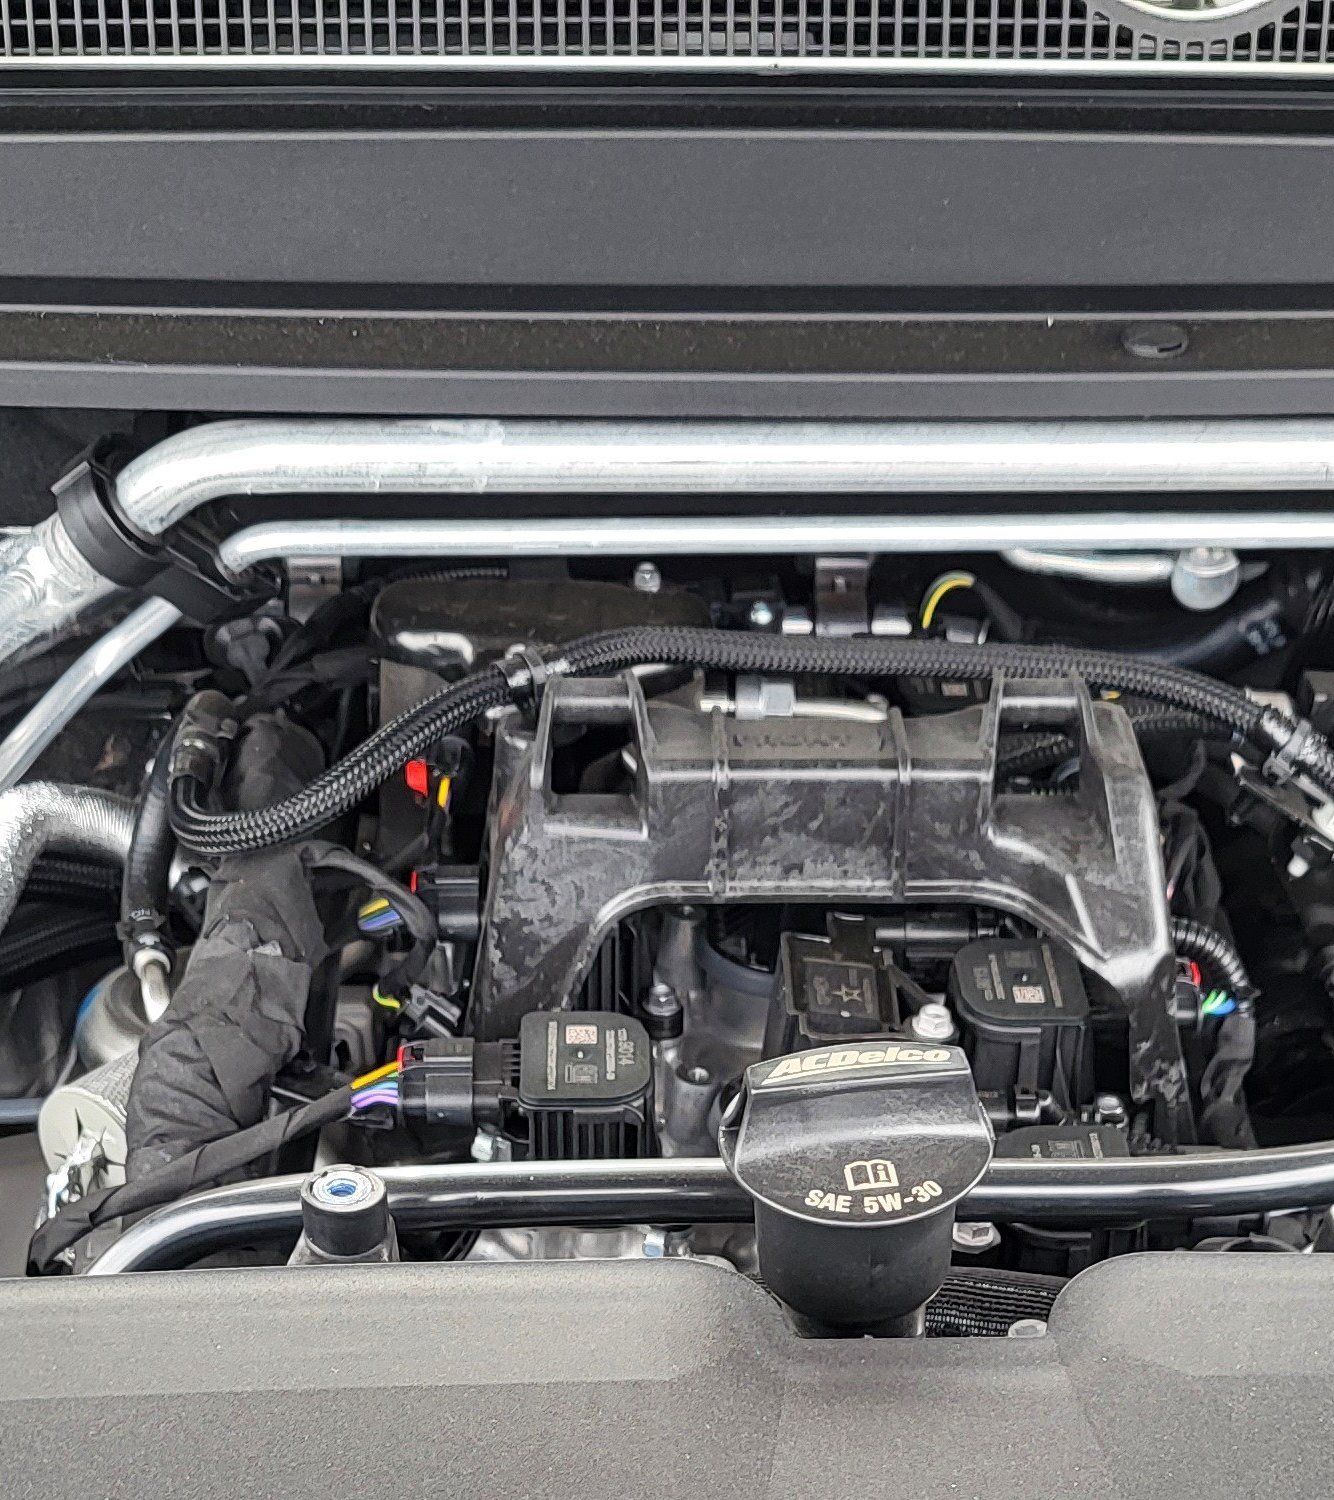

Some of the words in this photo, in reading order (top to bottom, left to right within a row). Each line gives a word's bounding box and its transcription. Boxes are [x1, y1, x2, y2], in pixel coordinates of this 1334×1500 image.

[767, 1047, 952, 1080] ACDelco
[804, 1189, 853, 1213] SAE
[863, 1180, 943, 1213] 5W-30
